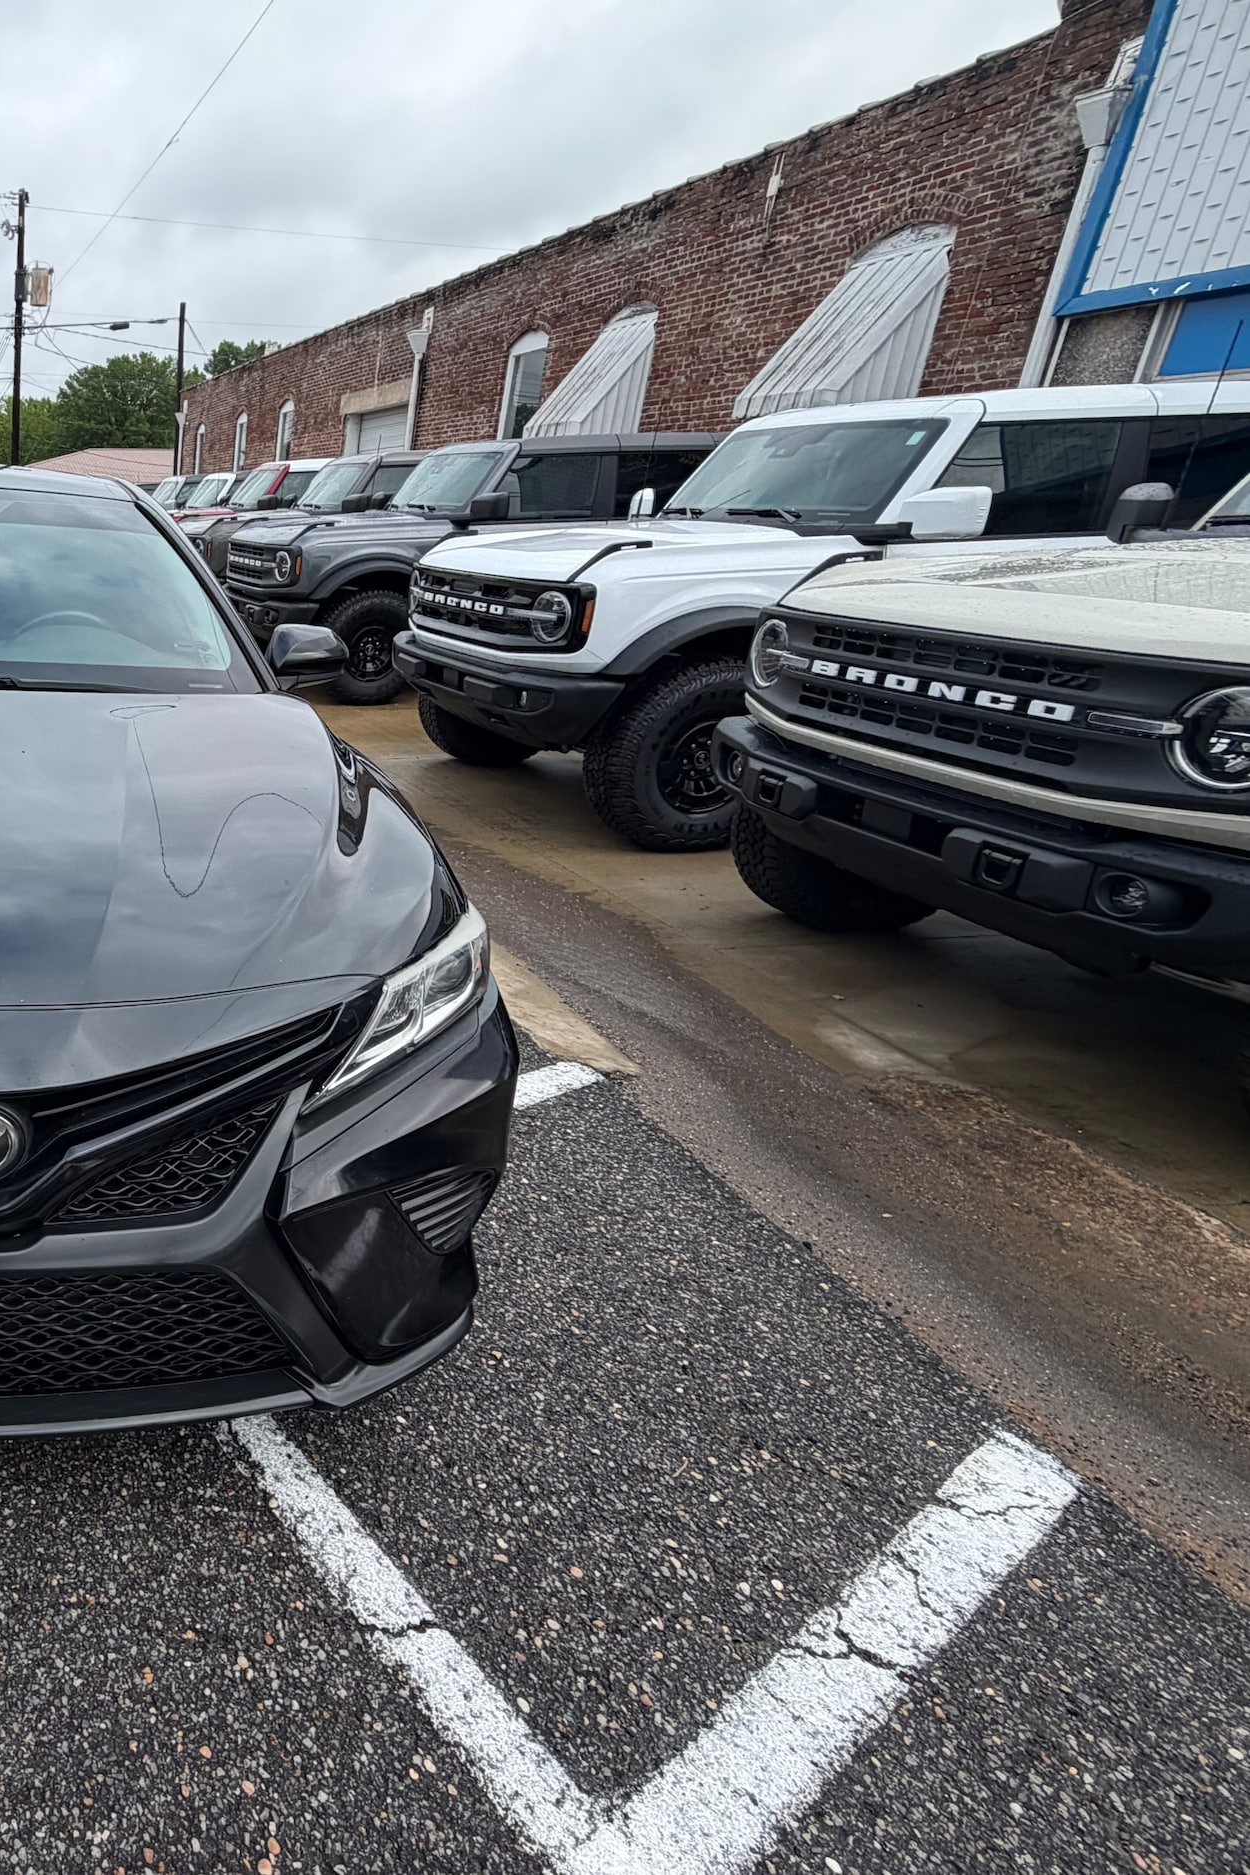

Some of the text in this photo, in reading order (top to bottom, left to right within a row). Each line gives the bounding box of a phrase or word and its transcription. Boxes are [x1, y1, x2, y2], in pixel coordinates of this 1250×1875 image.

[229, 555, 262, 567] BRONCO
[423, 591, 505, 616] BRONCO
[810, 659, 1076, 722] BRONCO
